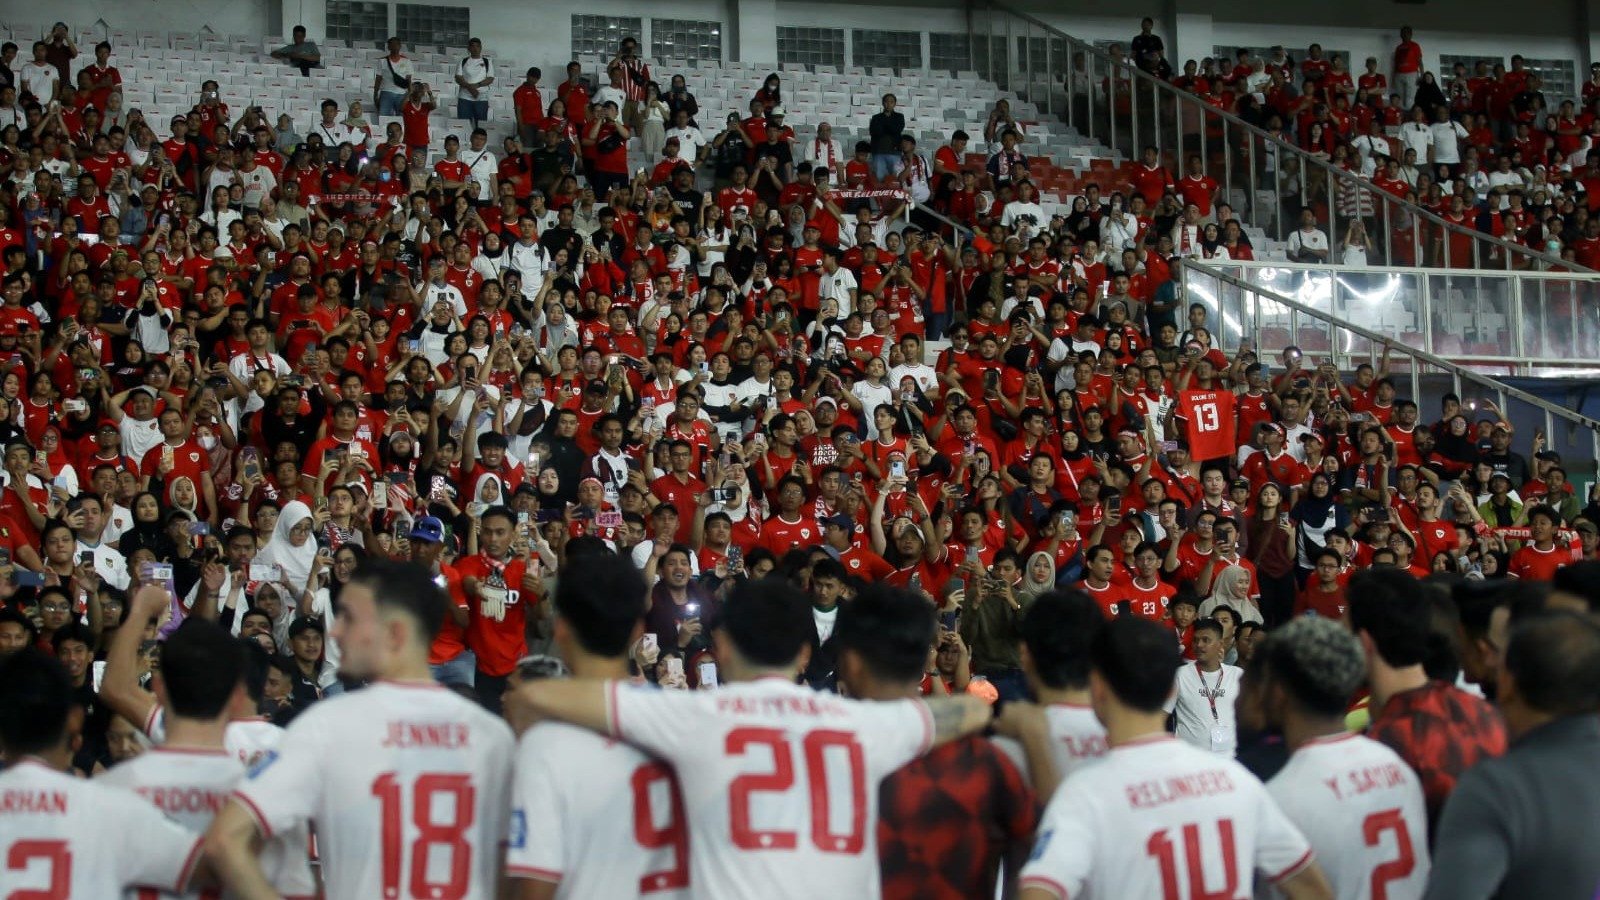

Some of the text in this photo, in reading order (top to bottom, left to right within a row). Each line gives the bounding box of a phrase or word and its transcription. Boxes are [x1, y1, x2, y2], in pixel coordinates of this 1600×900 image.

[840, 191, 853, 199] WE
[1193, 403, 1219, 432] 13
[1142, 602, 1155, 615] 23
[381, 720, 470, 749] JENNER
[1060, 733, 1110, 760] TJO
[0, 788, 67, 814] RHAN
[724, 726, 868, 855] 20
[371, 771, 476, 900] 18
[630, 760, 691, 895] 9
[6, 838, 73, 900] 2
[1145, 817, 1242, 900] 14
[1361, 807, 1416, 900] 2
